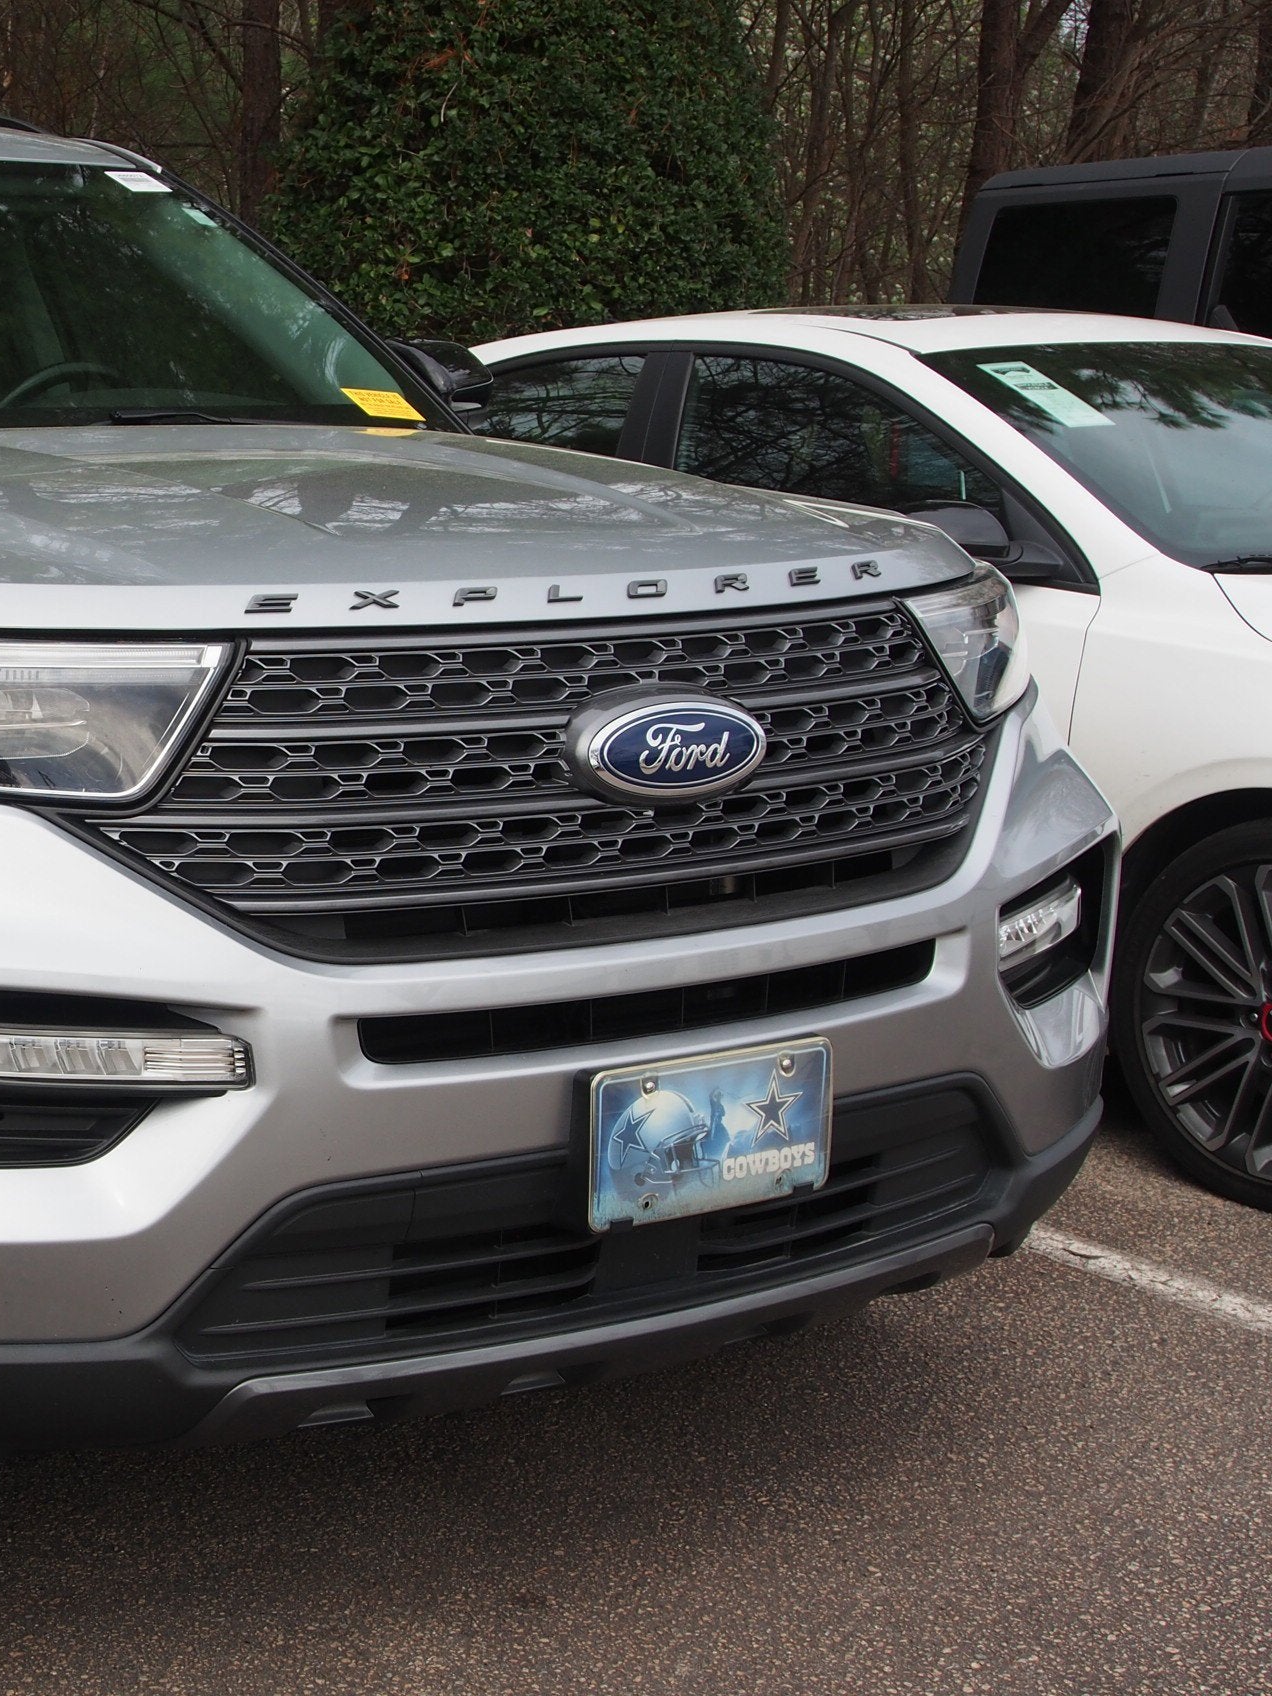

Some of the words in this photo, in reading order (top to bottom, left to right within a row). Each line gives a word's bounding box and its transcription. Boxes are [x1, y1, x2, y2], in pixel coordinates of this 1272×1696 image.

[244, 559, 883, 614] EXPLORER
[639, 721, 730, 775] Ford
[722, 1141, 815, 1181] COWBOYS
